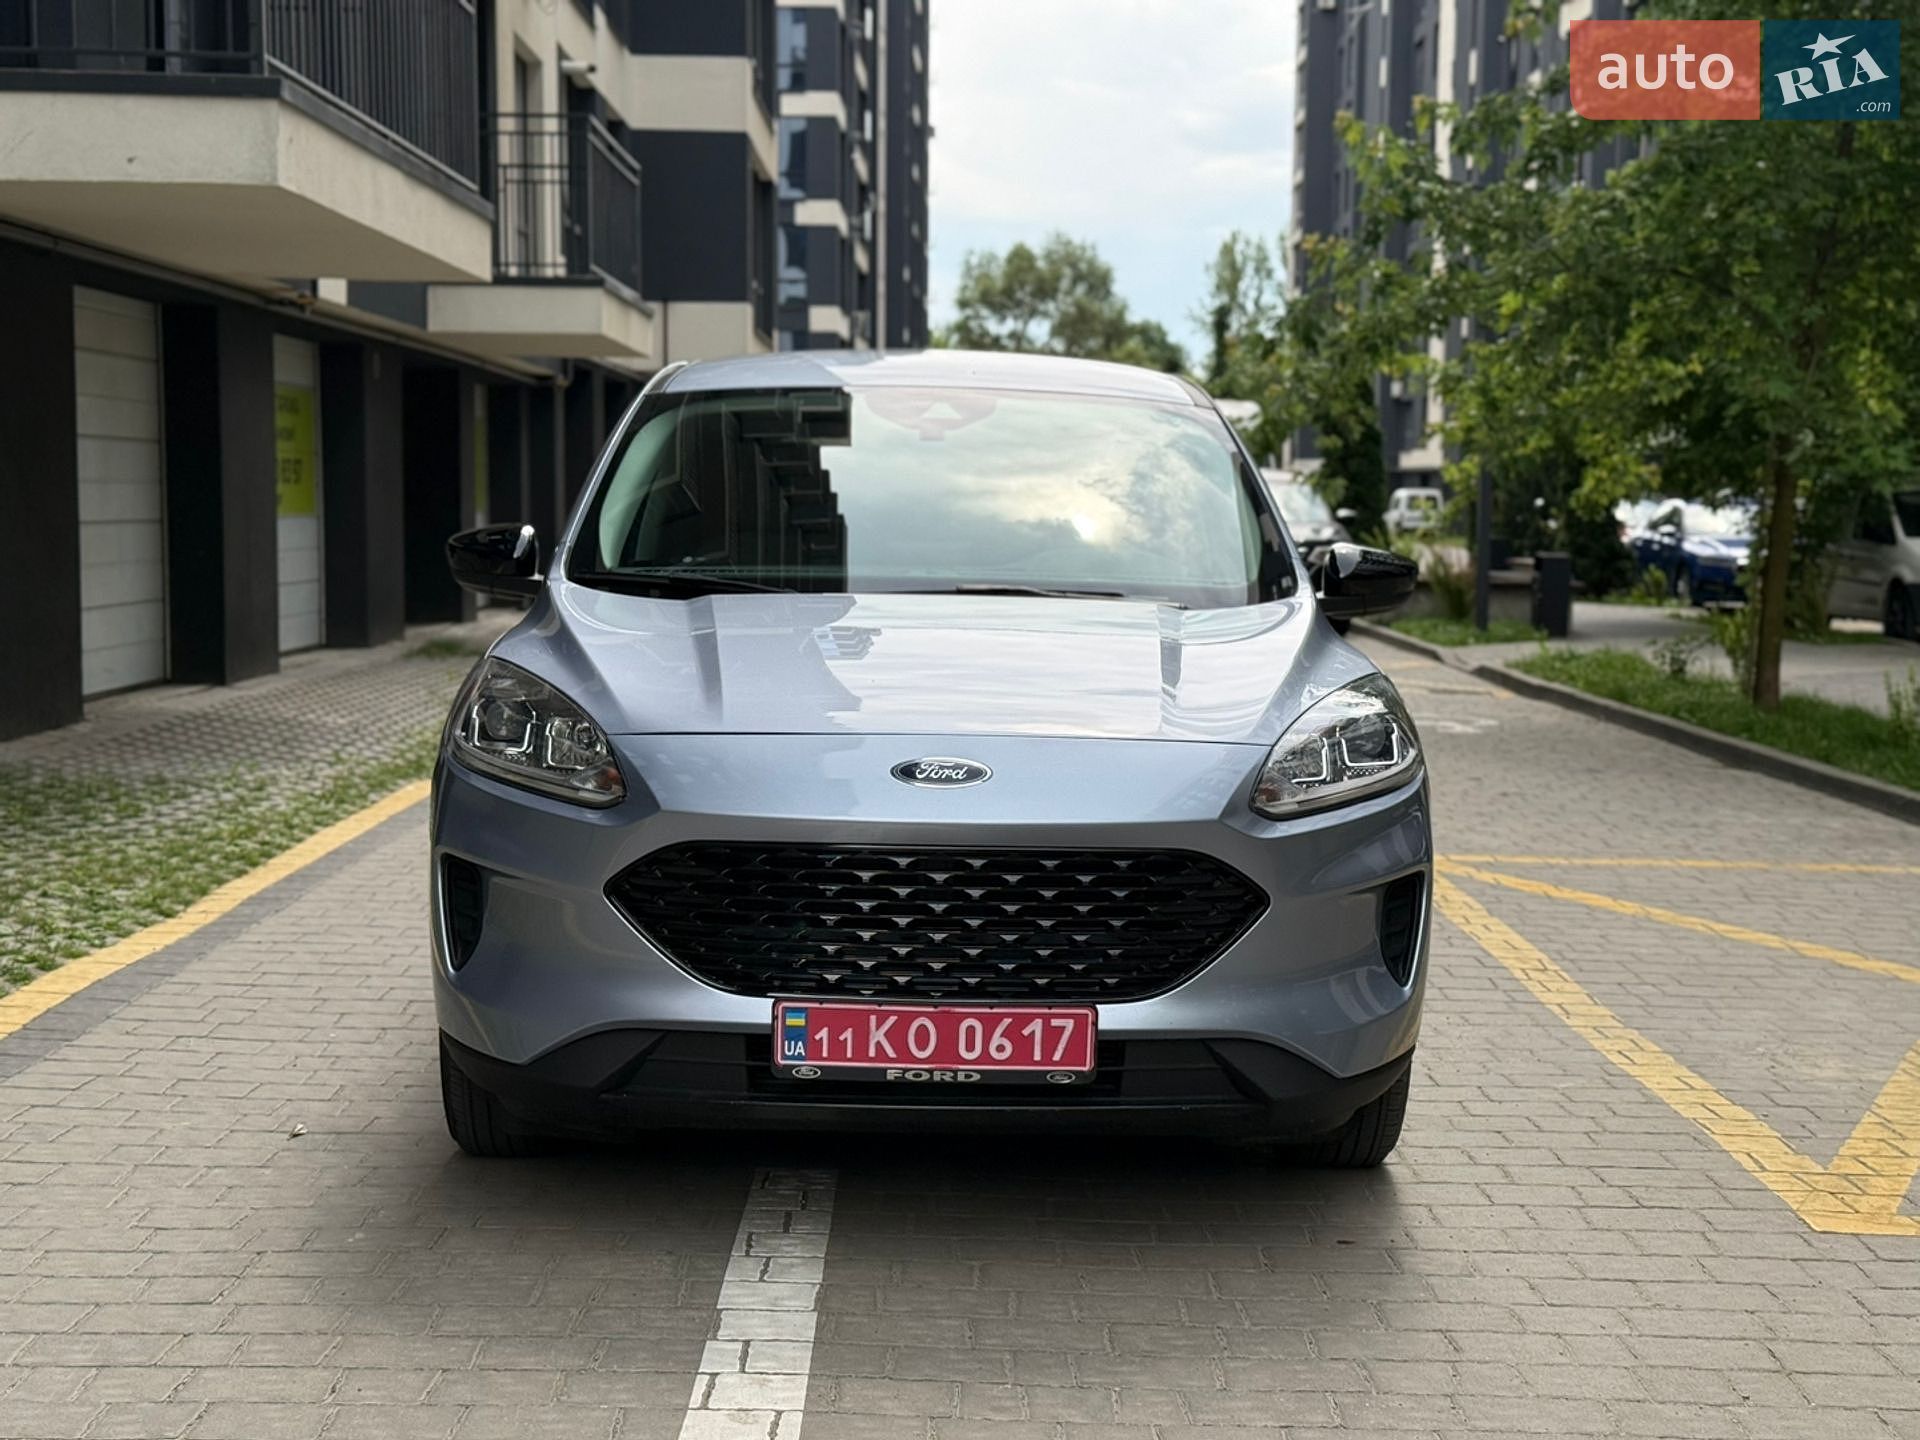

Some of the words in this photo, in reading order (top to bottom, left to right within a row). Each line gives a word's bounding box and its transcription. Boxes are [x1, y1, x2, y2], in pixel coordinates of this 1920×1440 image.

[915, 762, 968, 779] Ford
[784, 1040, 805, 1056] UA
[958, 1018, 1075, 1062] 0617
[886, 1069, 981, 1083] FORD
